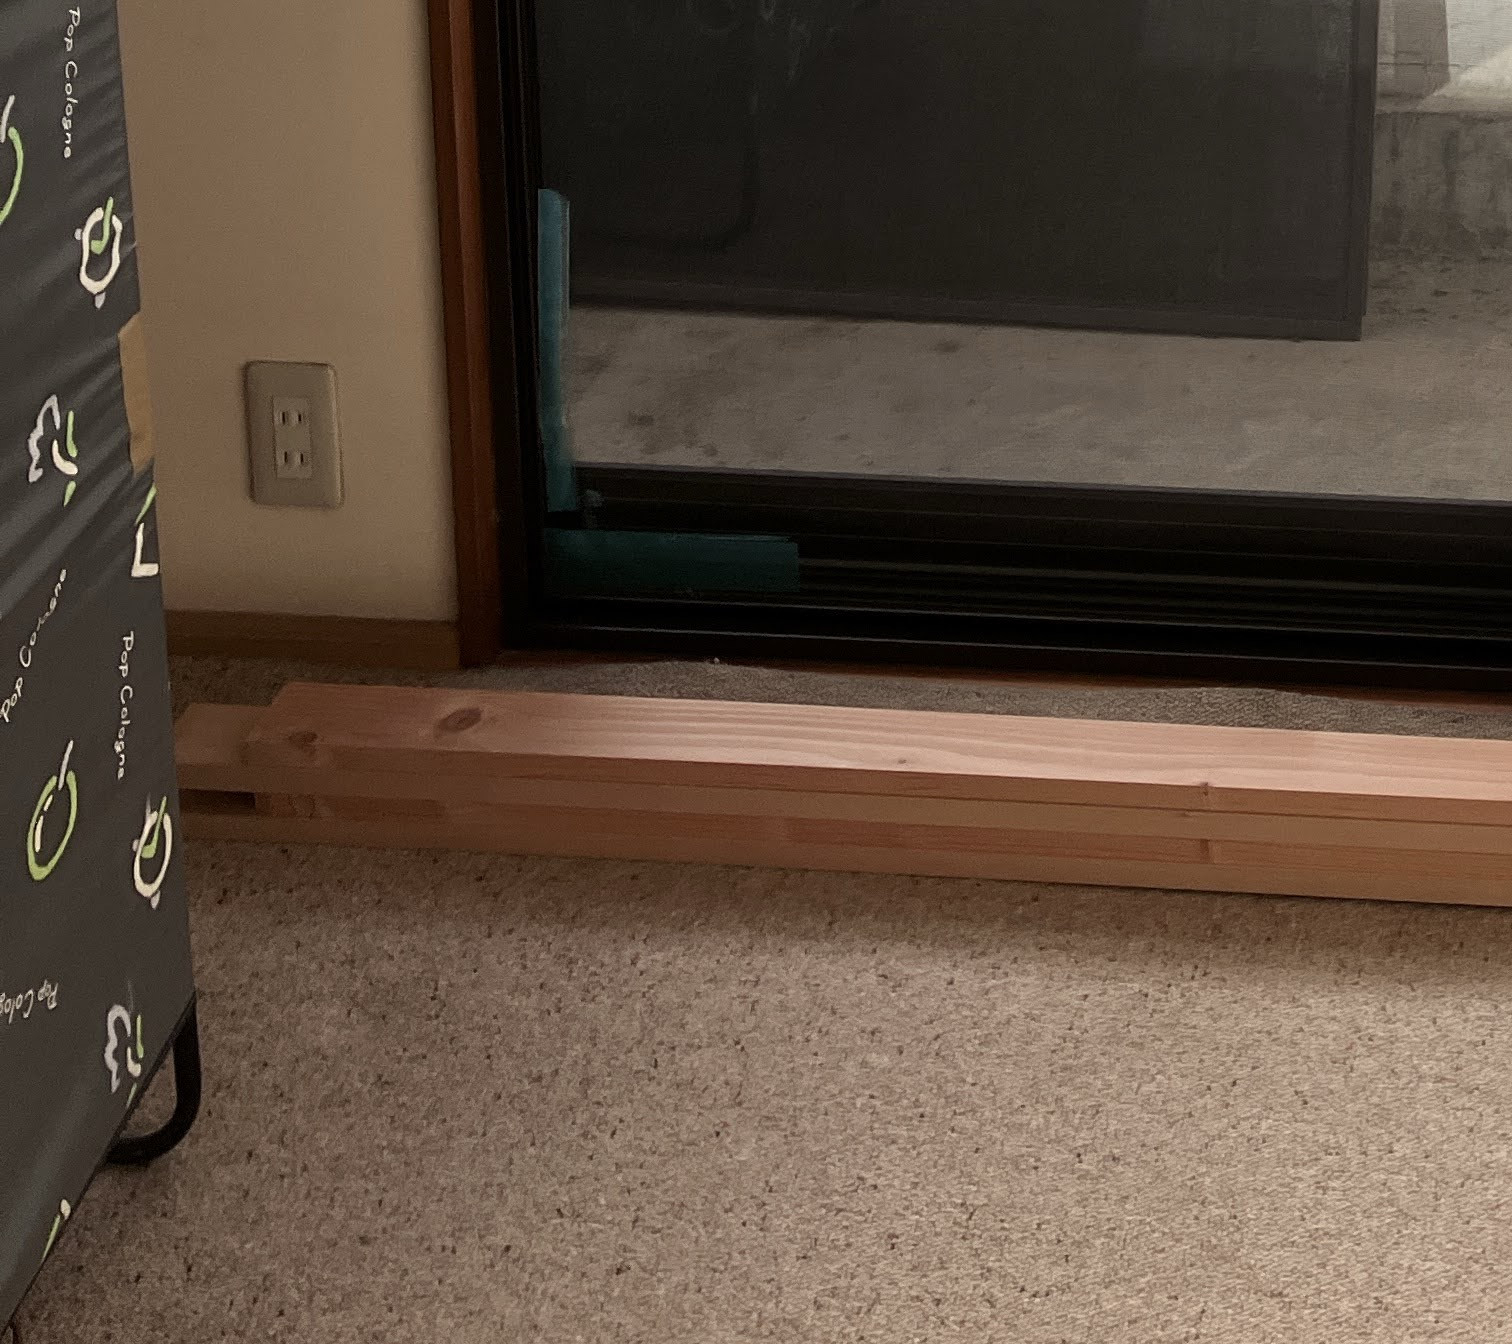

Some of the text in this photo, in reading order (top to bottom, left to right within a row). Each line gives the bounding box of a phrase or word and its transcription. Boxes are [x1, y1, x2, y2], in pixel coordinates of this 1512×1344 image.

[61, 5, 81, 159] Pop Cologne
[0, 676, 24, 723] Pop
[113, 630, 135, 780] Pop Cologne
